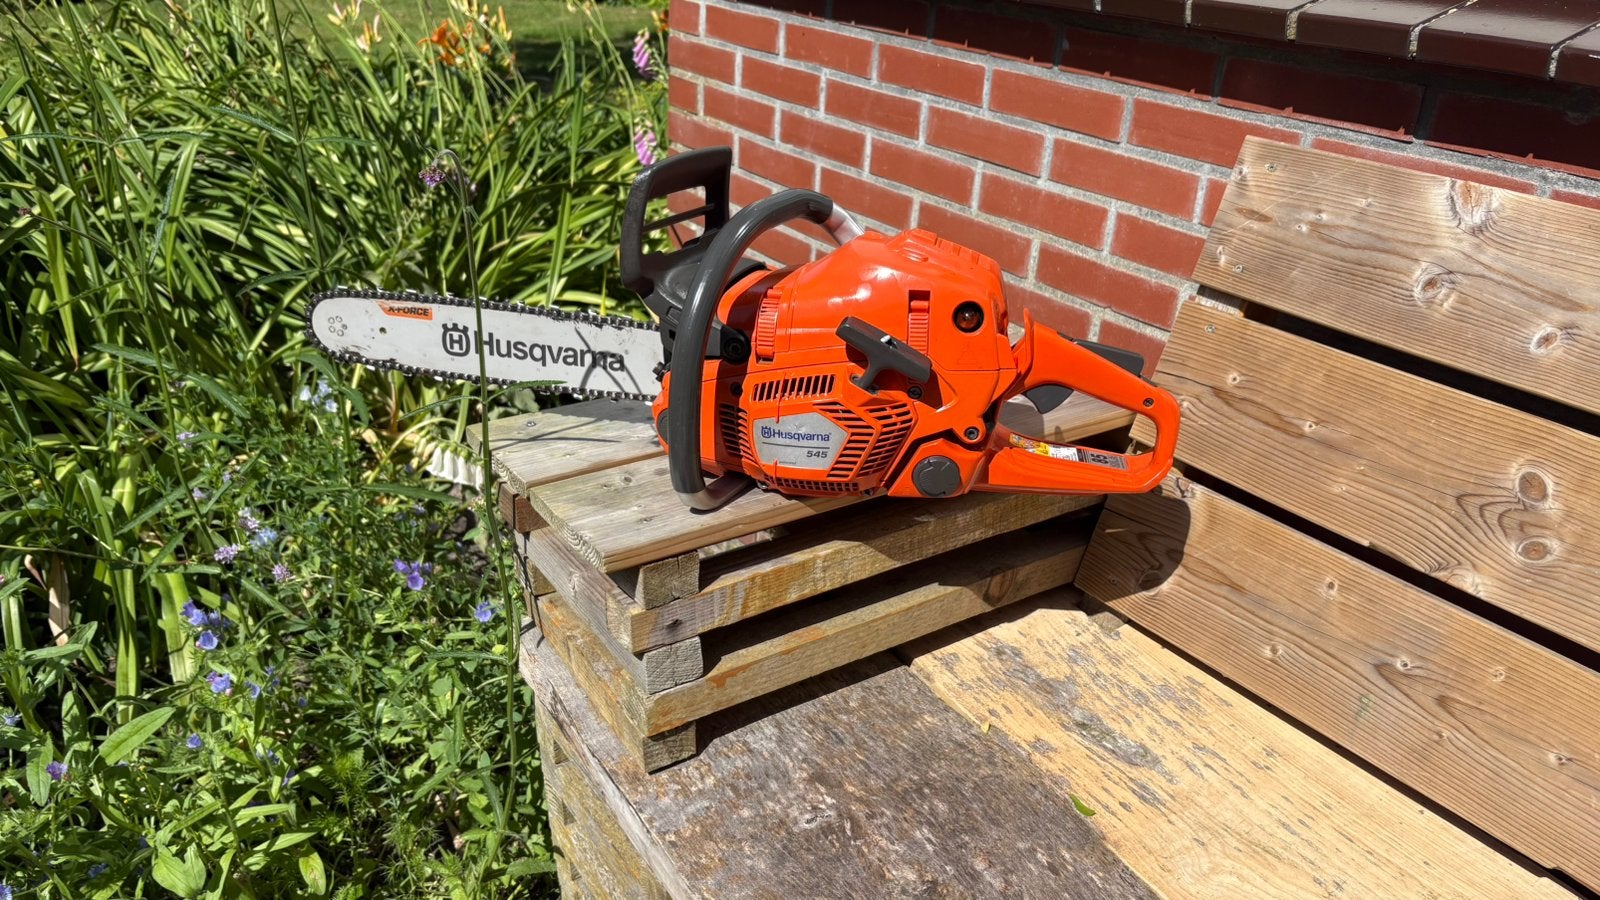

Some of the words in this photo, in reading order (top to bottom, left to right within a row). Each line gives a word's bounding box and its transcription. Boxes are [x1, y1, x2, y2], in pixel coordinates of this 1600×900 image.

[388, 306, 430, 317] X-FORCE
[474, 330, 625, 371] Husqvarna
[773, 429, 830, 442] Husqvarna
[806, 450, 828, 458] 545
